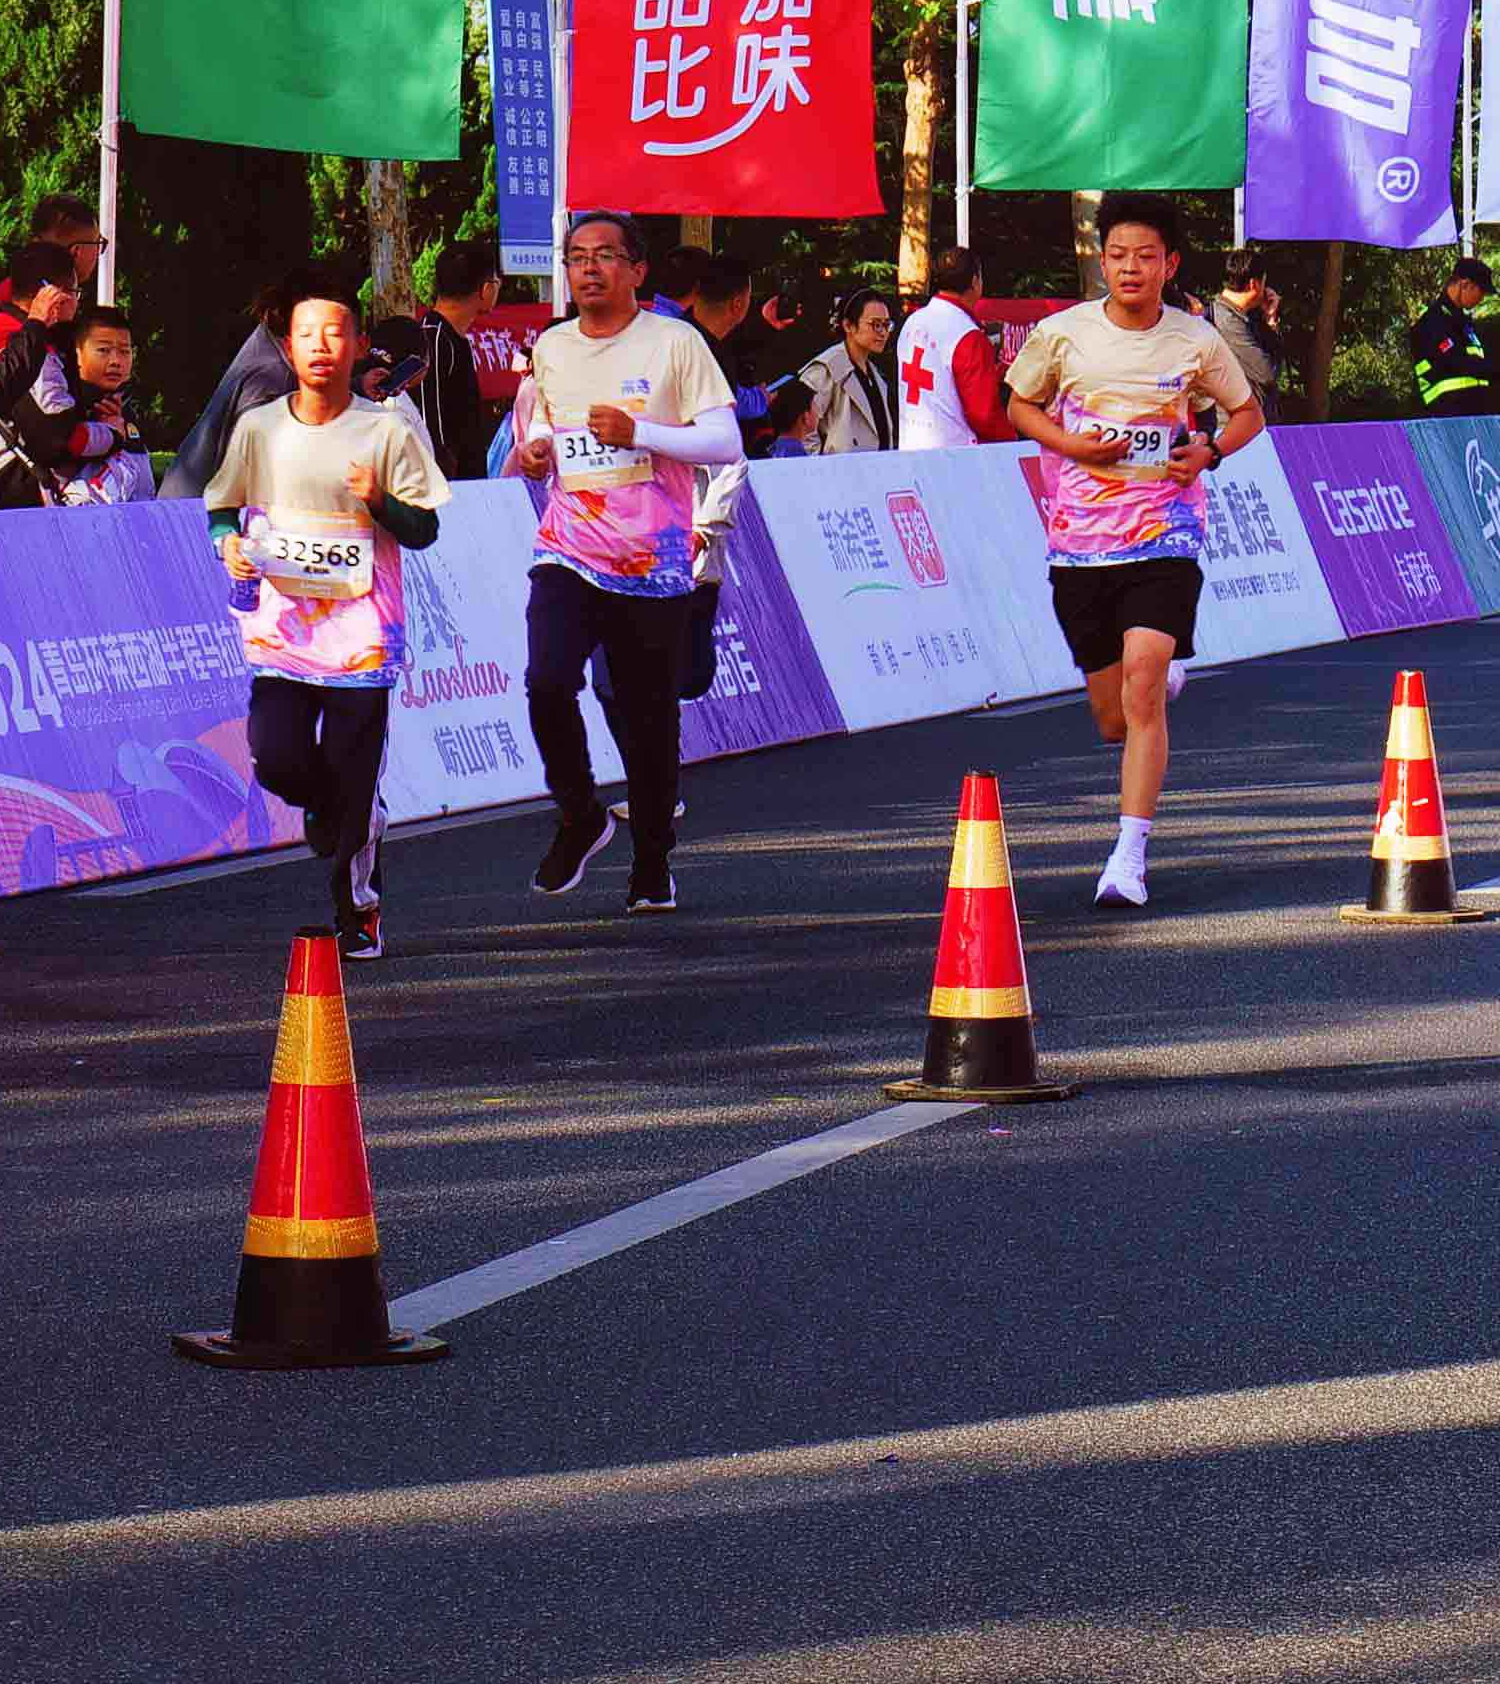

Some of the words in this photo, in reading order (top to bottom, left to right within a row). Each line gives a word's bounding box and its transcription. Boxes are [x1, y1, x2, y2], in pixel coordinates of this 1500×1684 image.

[1312, 477, 1416, 537] Casarte
[276, 537, 361, 568] 32568
[401, 634, 511, 709] Laoshan
[434, 717, 525, 777] 崂山矿泉
